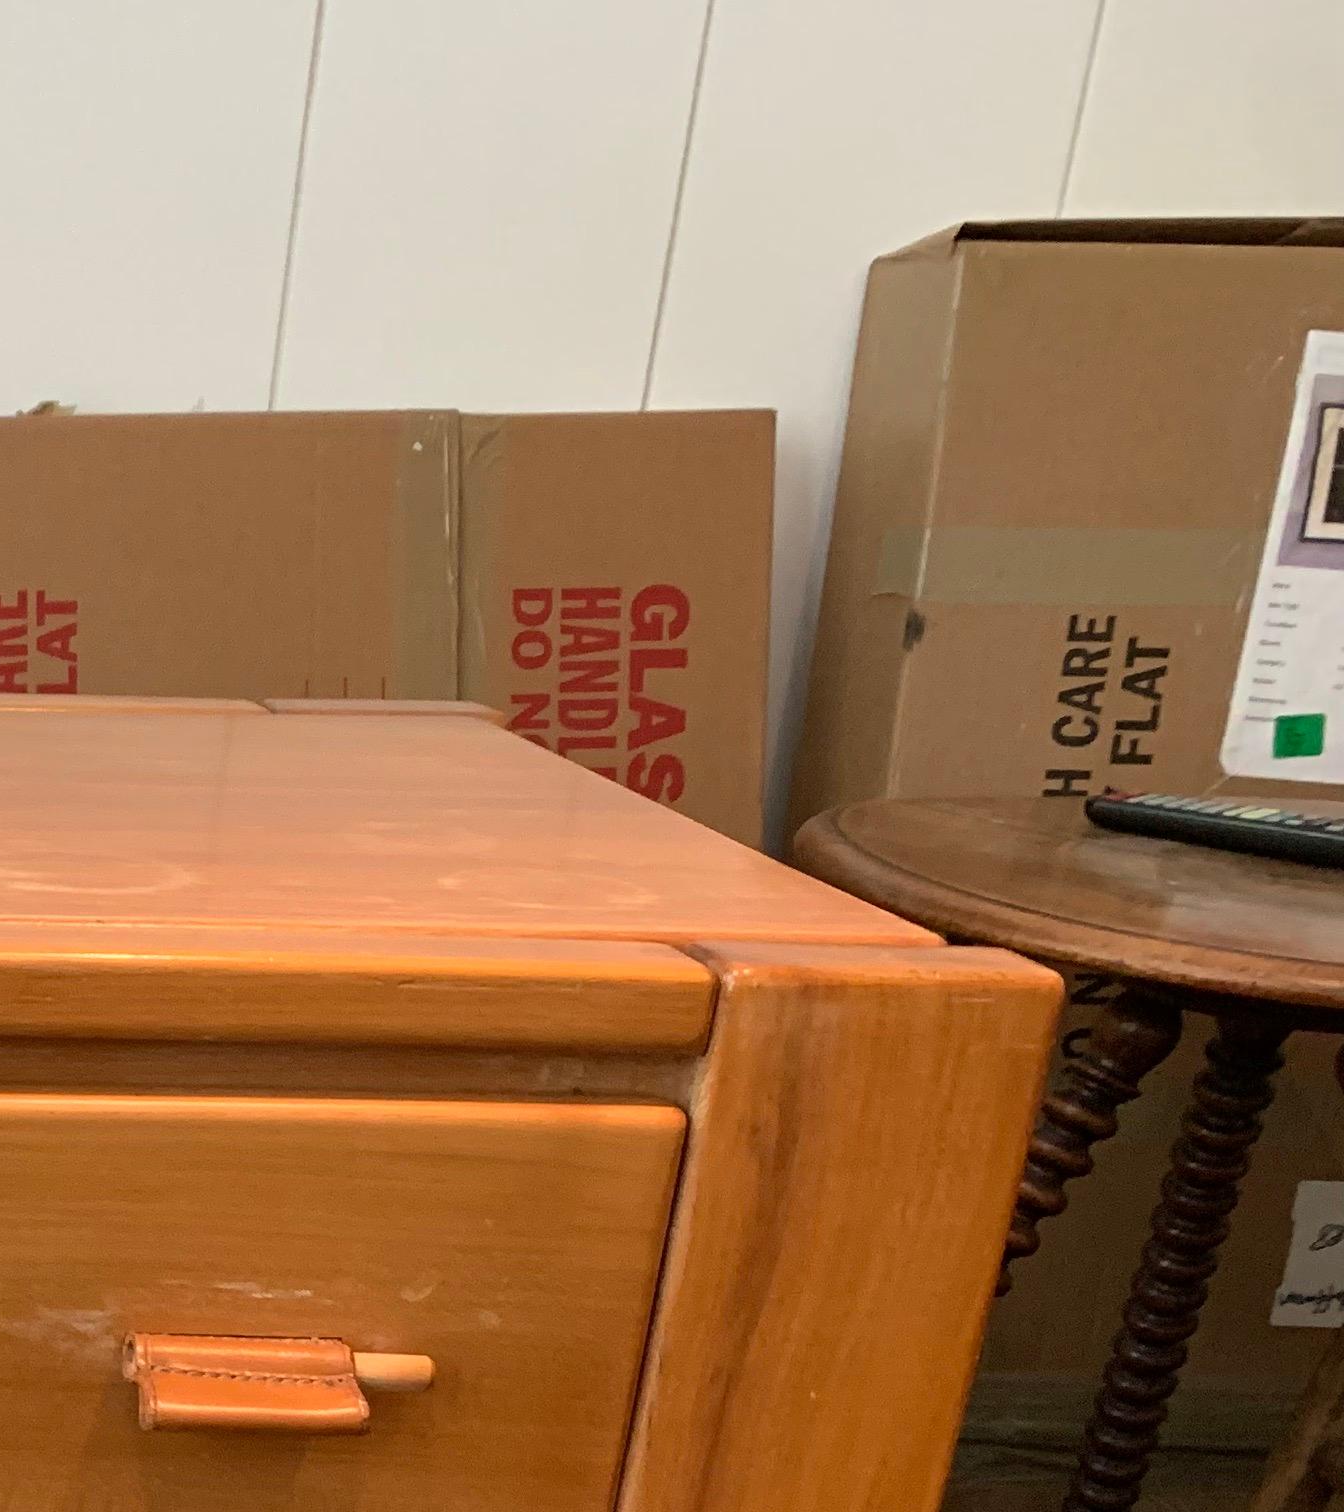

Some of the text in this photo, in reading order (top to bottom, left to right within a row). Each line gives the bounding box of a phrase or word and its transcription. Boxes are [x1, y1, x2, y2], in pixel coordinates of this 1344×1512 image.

[505, 587, 553, 750] DO N
[557, 587, 623, 782] HANDL
[1052, 614, 1117, 747] CARE
[1110, 636, 1170, 765] FLAT
